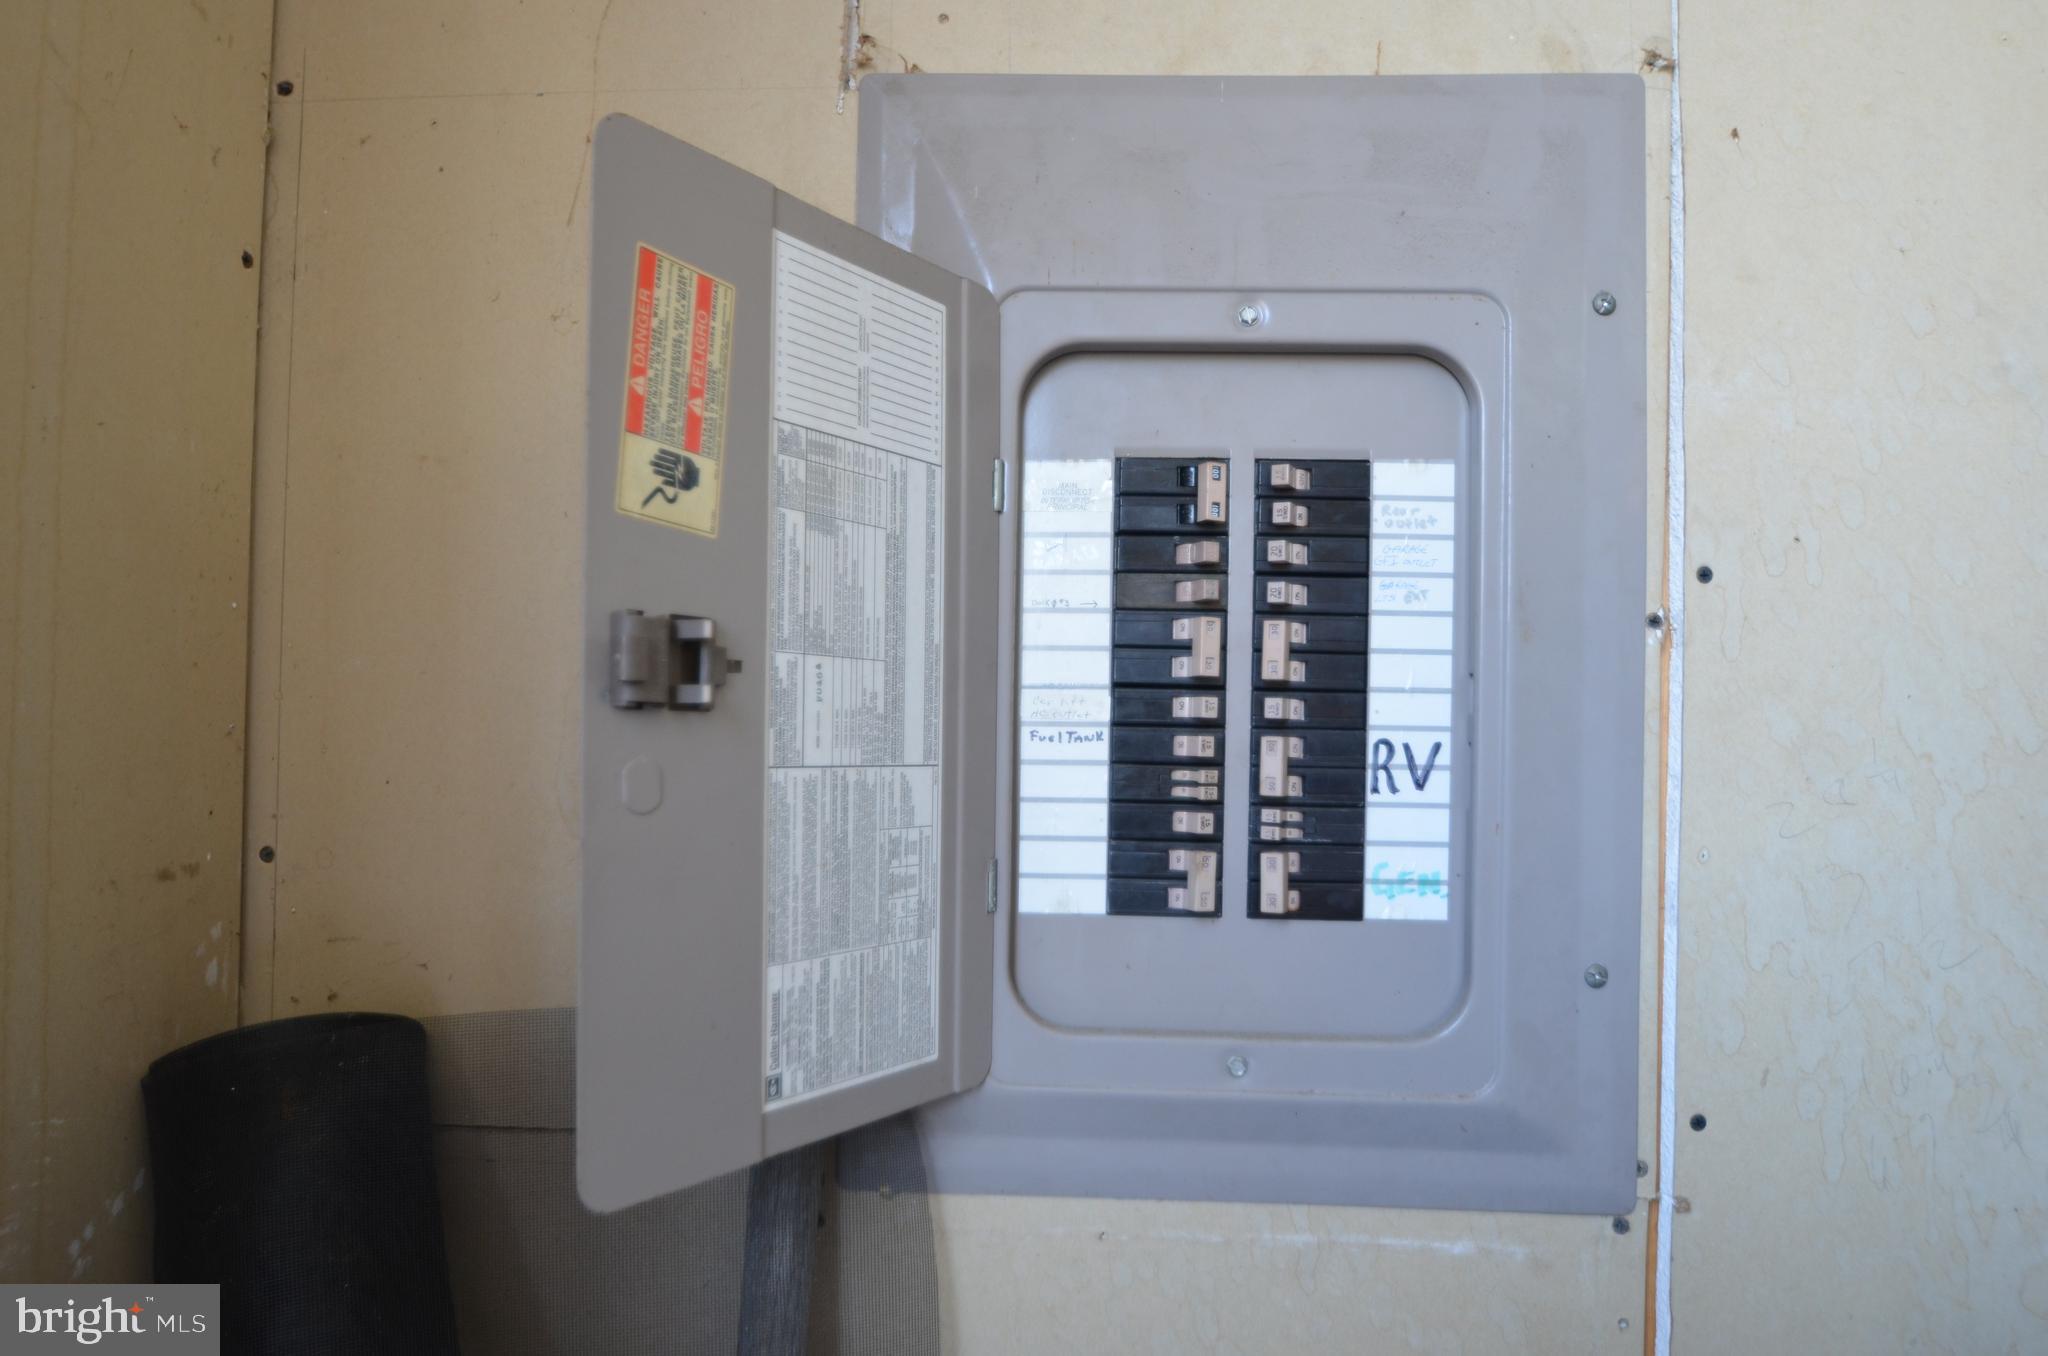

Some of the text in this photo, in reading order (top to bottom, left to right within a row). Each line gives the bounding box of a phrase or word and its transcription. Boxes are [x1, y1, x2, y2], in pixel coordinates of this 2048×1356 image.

[633, 287, 651, 368] DANGER
[692, 309, 708, 389] PELIGRO
[1029, 730, 1062, 744] Fuel
[1370, 738, 1442, 795] RV
